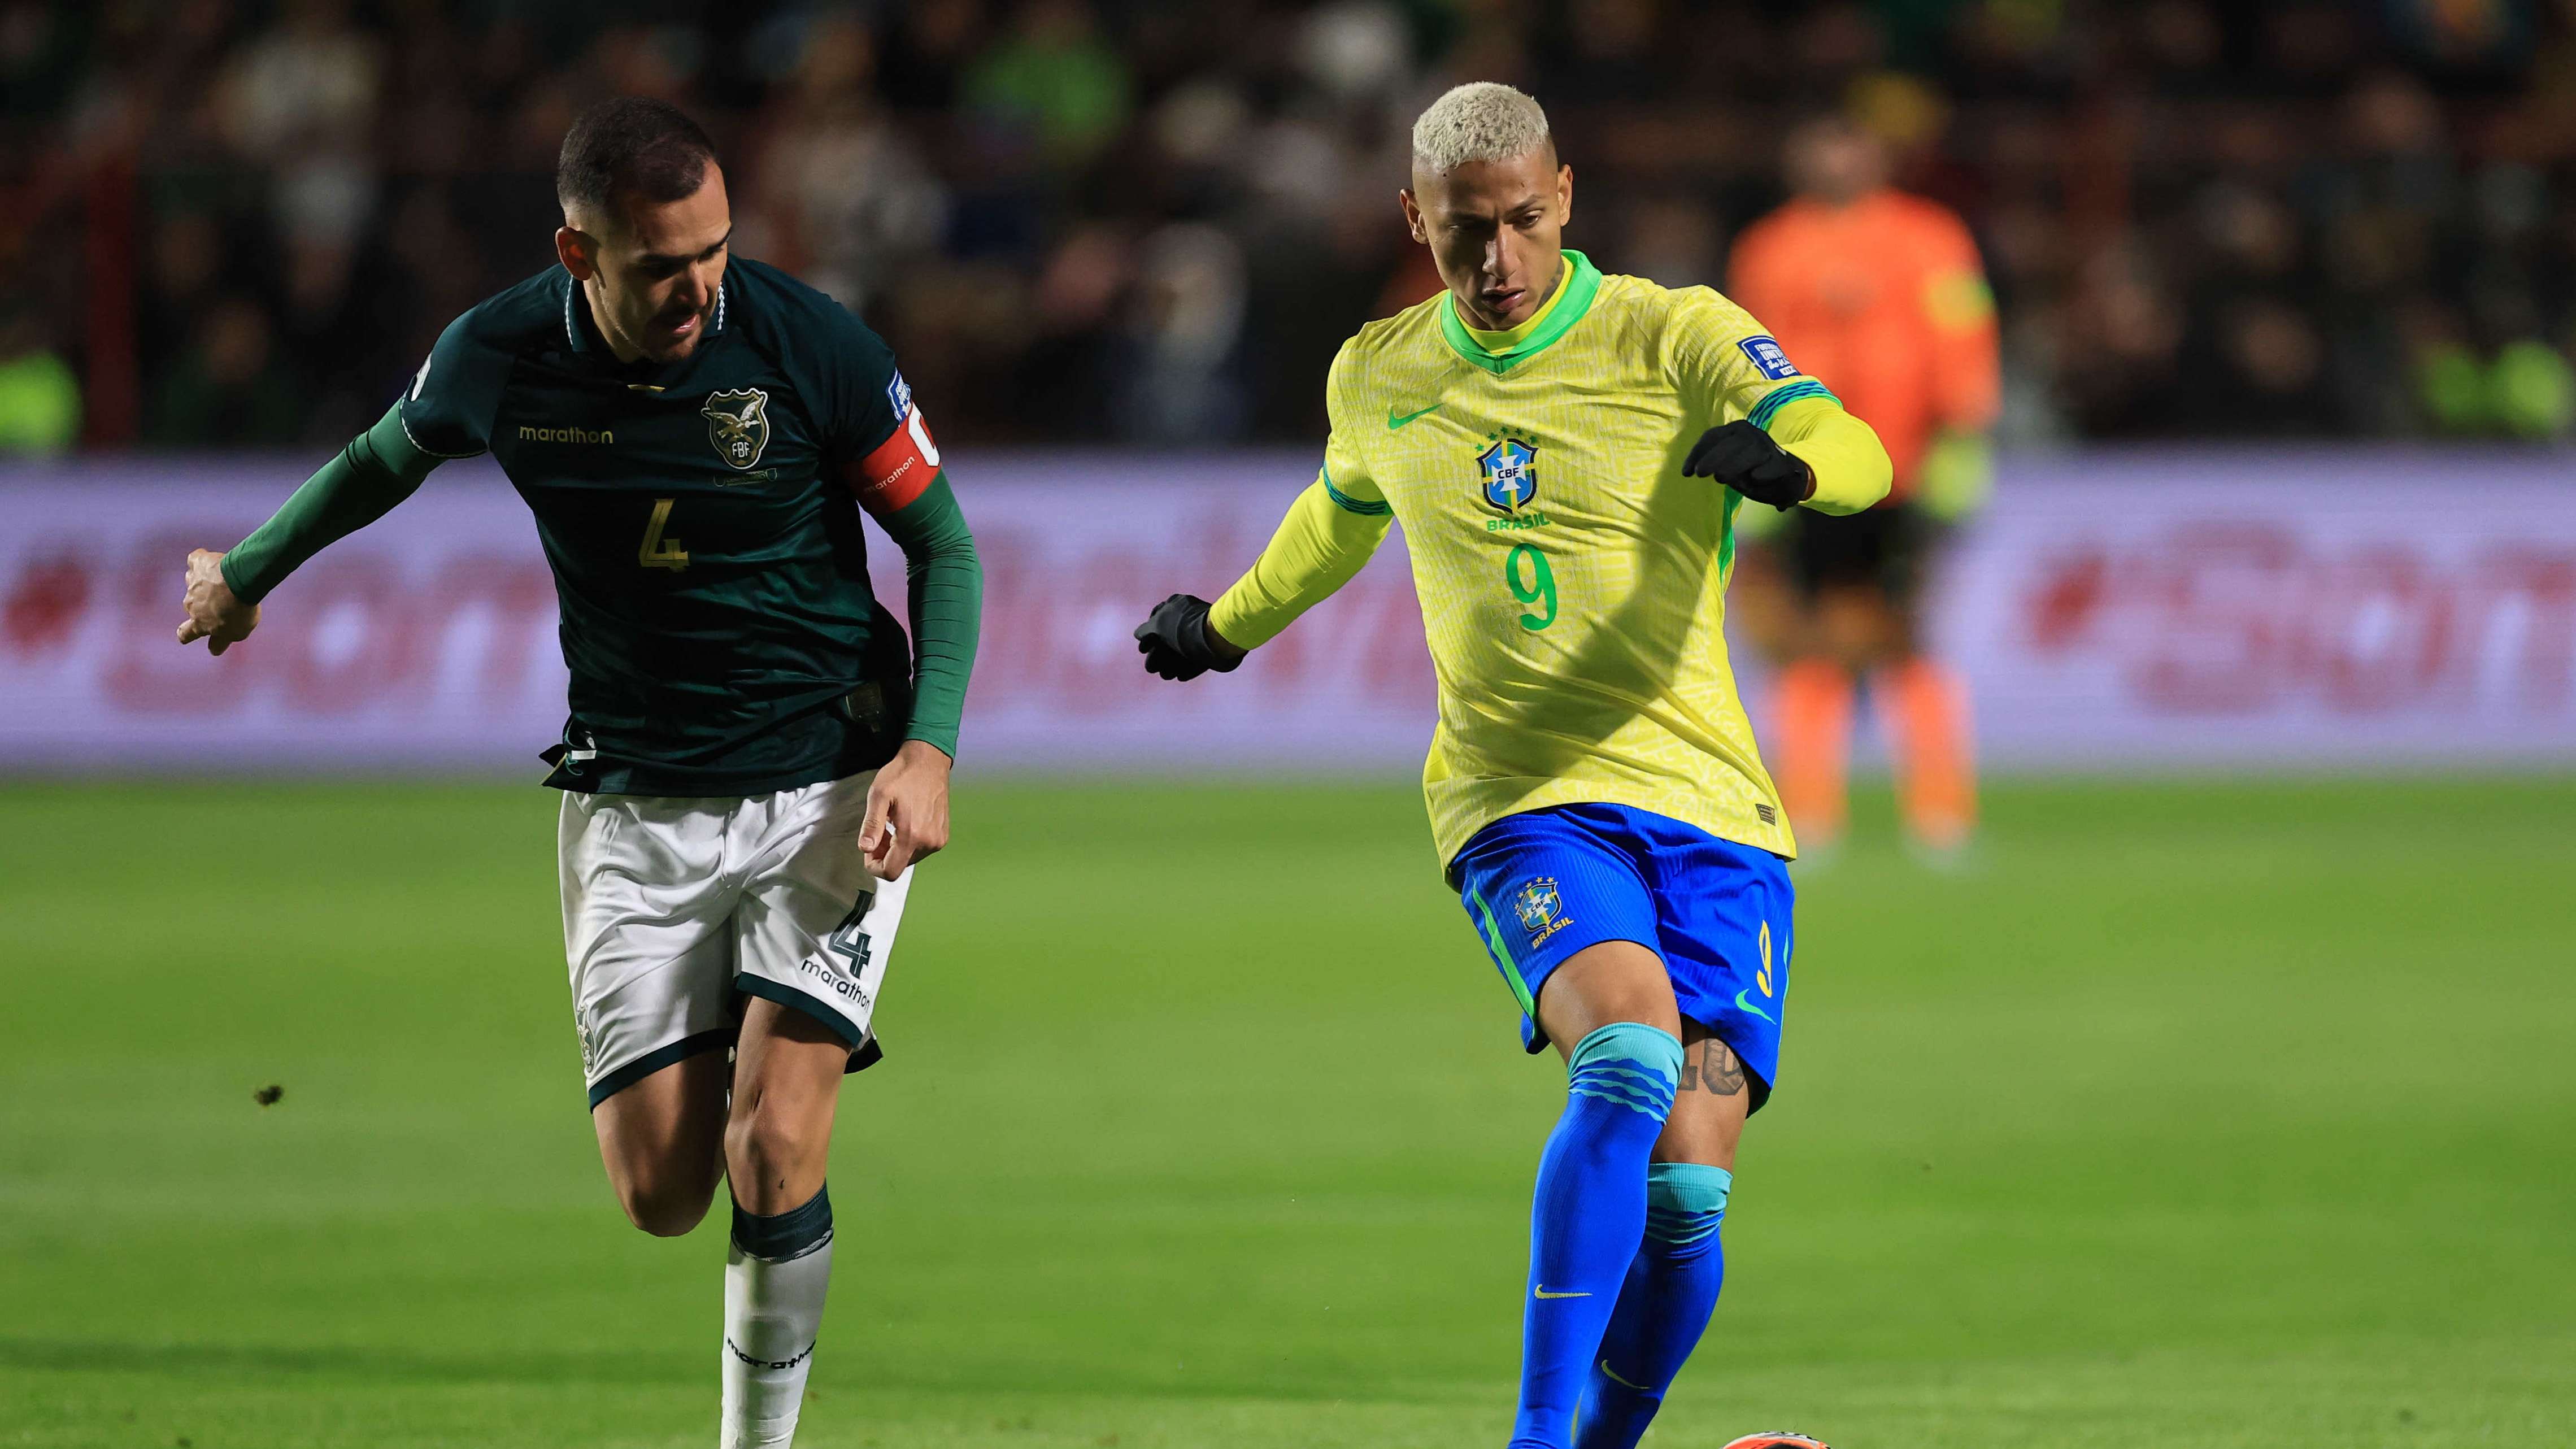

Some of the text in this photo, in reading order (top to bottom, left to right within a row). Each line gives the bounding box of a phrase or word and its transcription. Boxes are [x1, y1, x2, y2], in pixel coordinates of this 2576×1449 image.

[520, 427, 613, 443] marathon
[732, 442, 750, 458] FBF
[1498, 467, 1519, 479] CBF
[638, 498, 690, 572] 4
[1486, 513, 1550, 531] BRASIL
[1506, 543, 1557, 631] 9
[1531, 899, 1546, 912] CBF
[827, 889, 874, 979] 4
[1532, 917, 1574, 950] BRASIL
[1757, 919, 1772, 998] 9
[801, 959, 871, 1013] marathon
